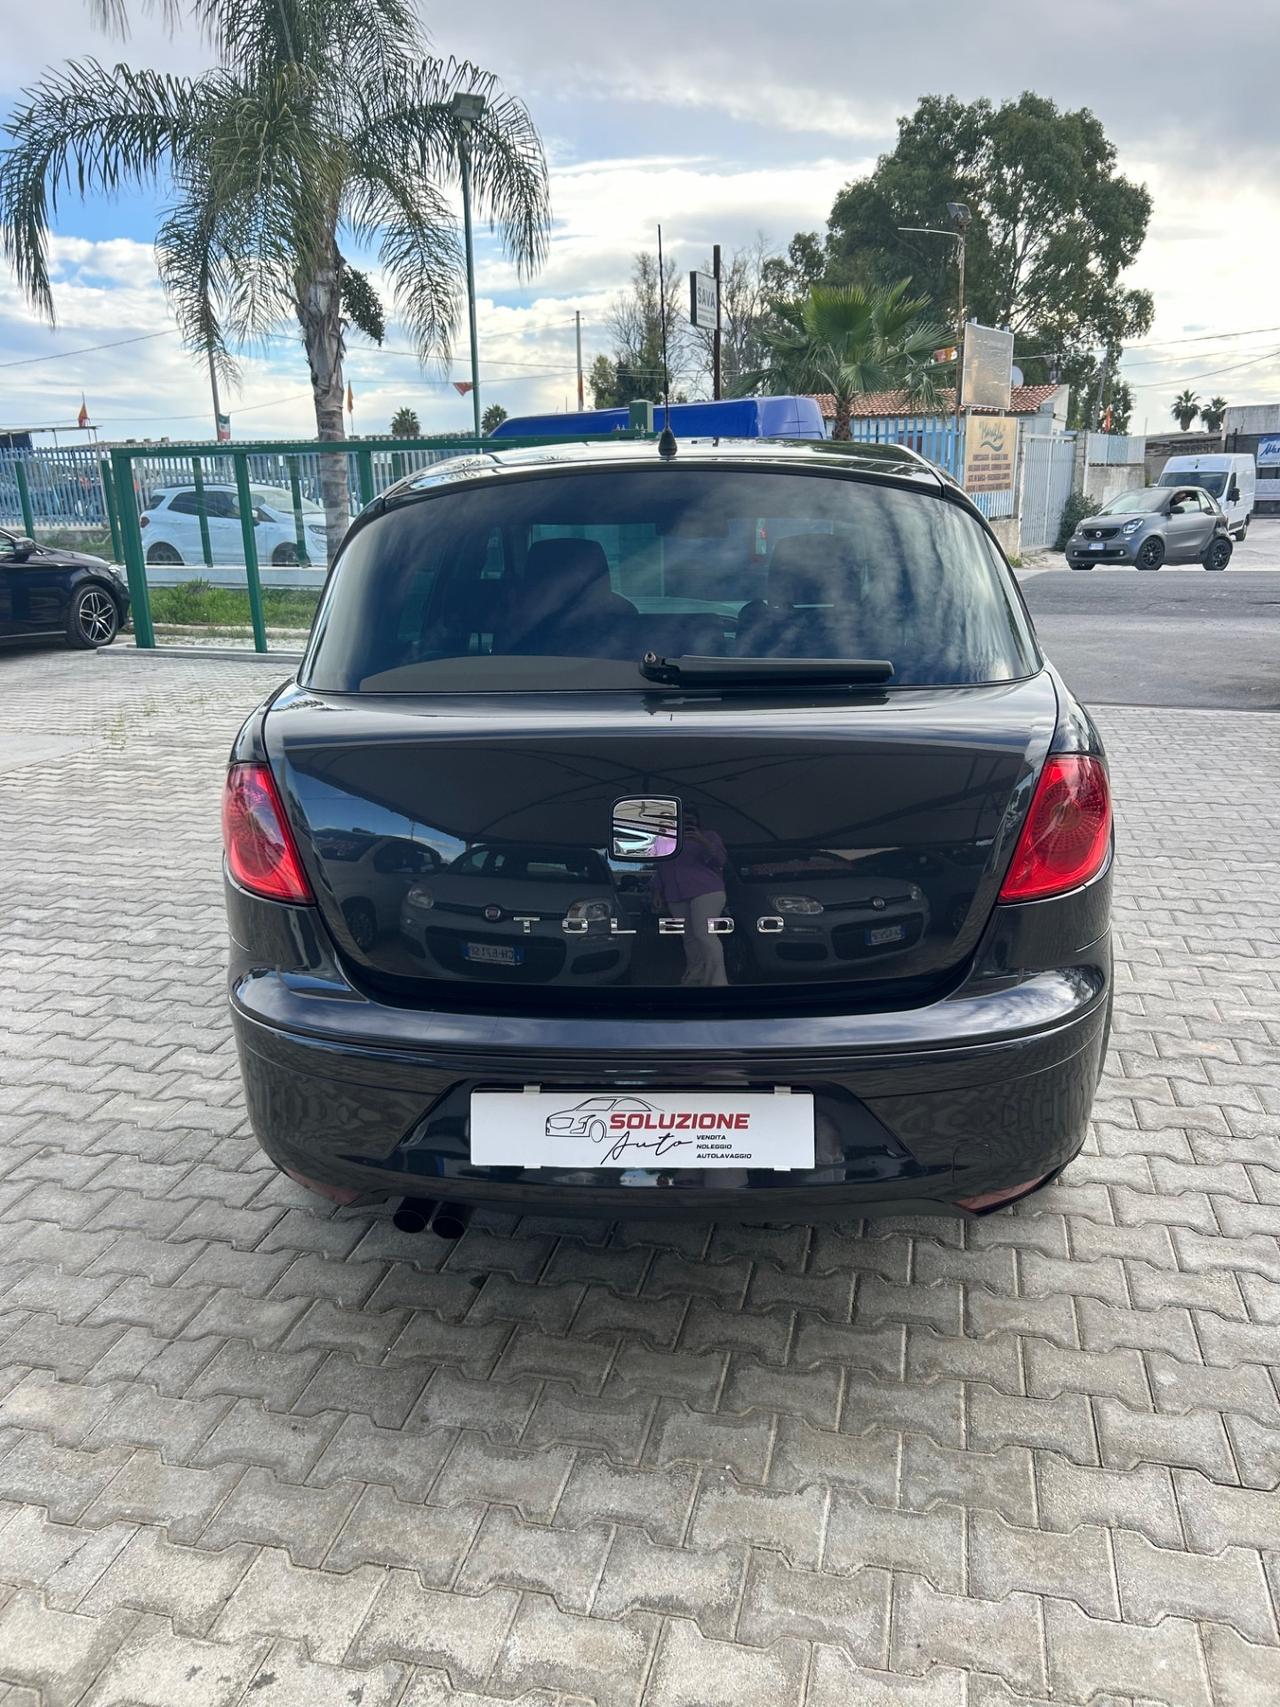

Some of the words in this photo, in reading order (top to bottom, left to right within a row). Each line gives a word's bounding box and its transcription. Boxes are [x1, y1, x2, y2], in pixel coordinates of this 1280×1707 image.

[513, 917, 785, 934] TOLEDO
[609, 1113, 751, 1130] SOLUZIONE
[600, 1130, 693, 1165] Auto
[696, 1152, 752, 1160] AUTOLAVAGGIO
